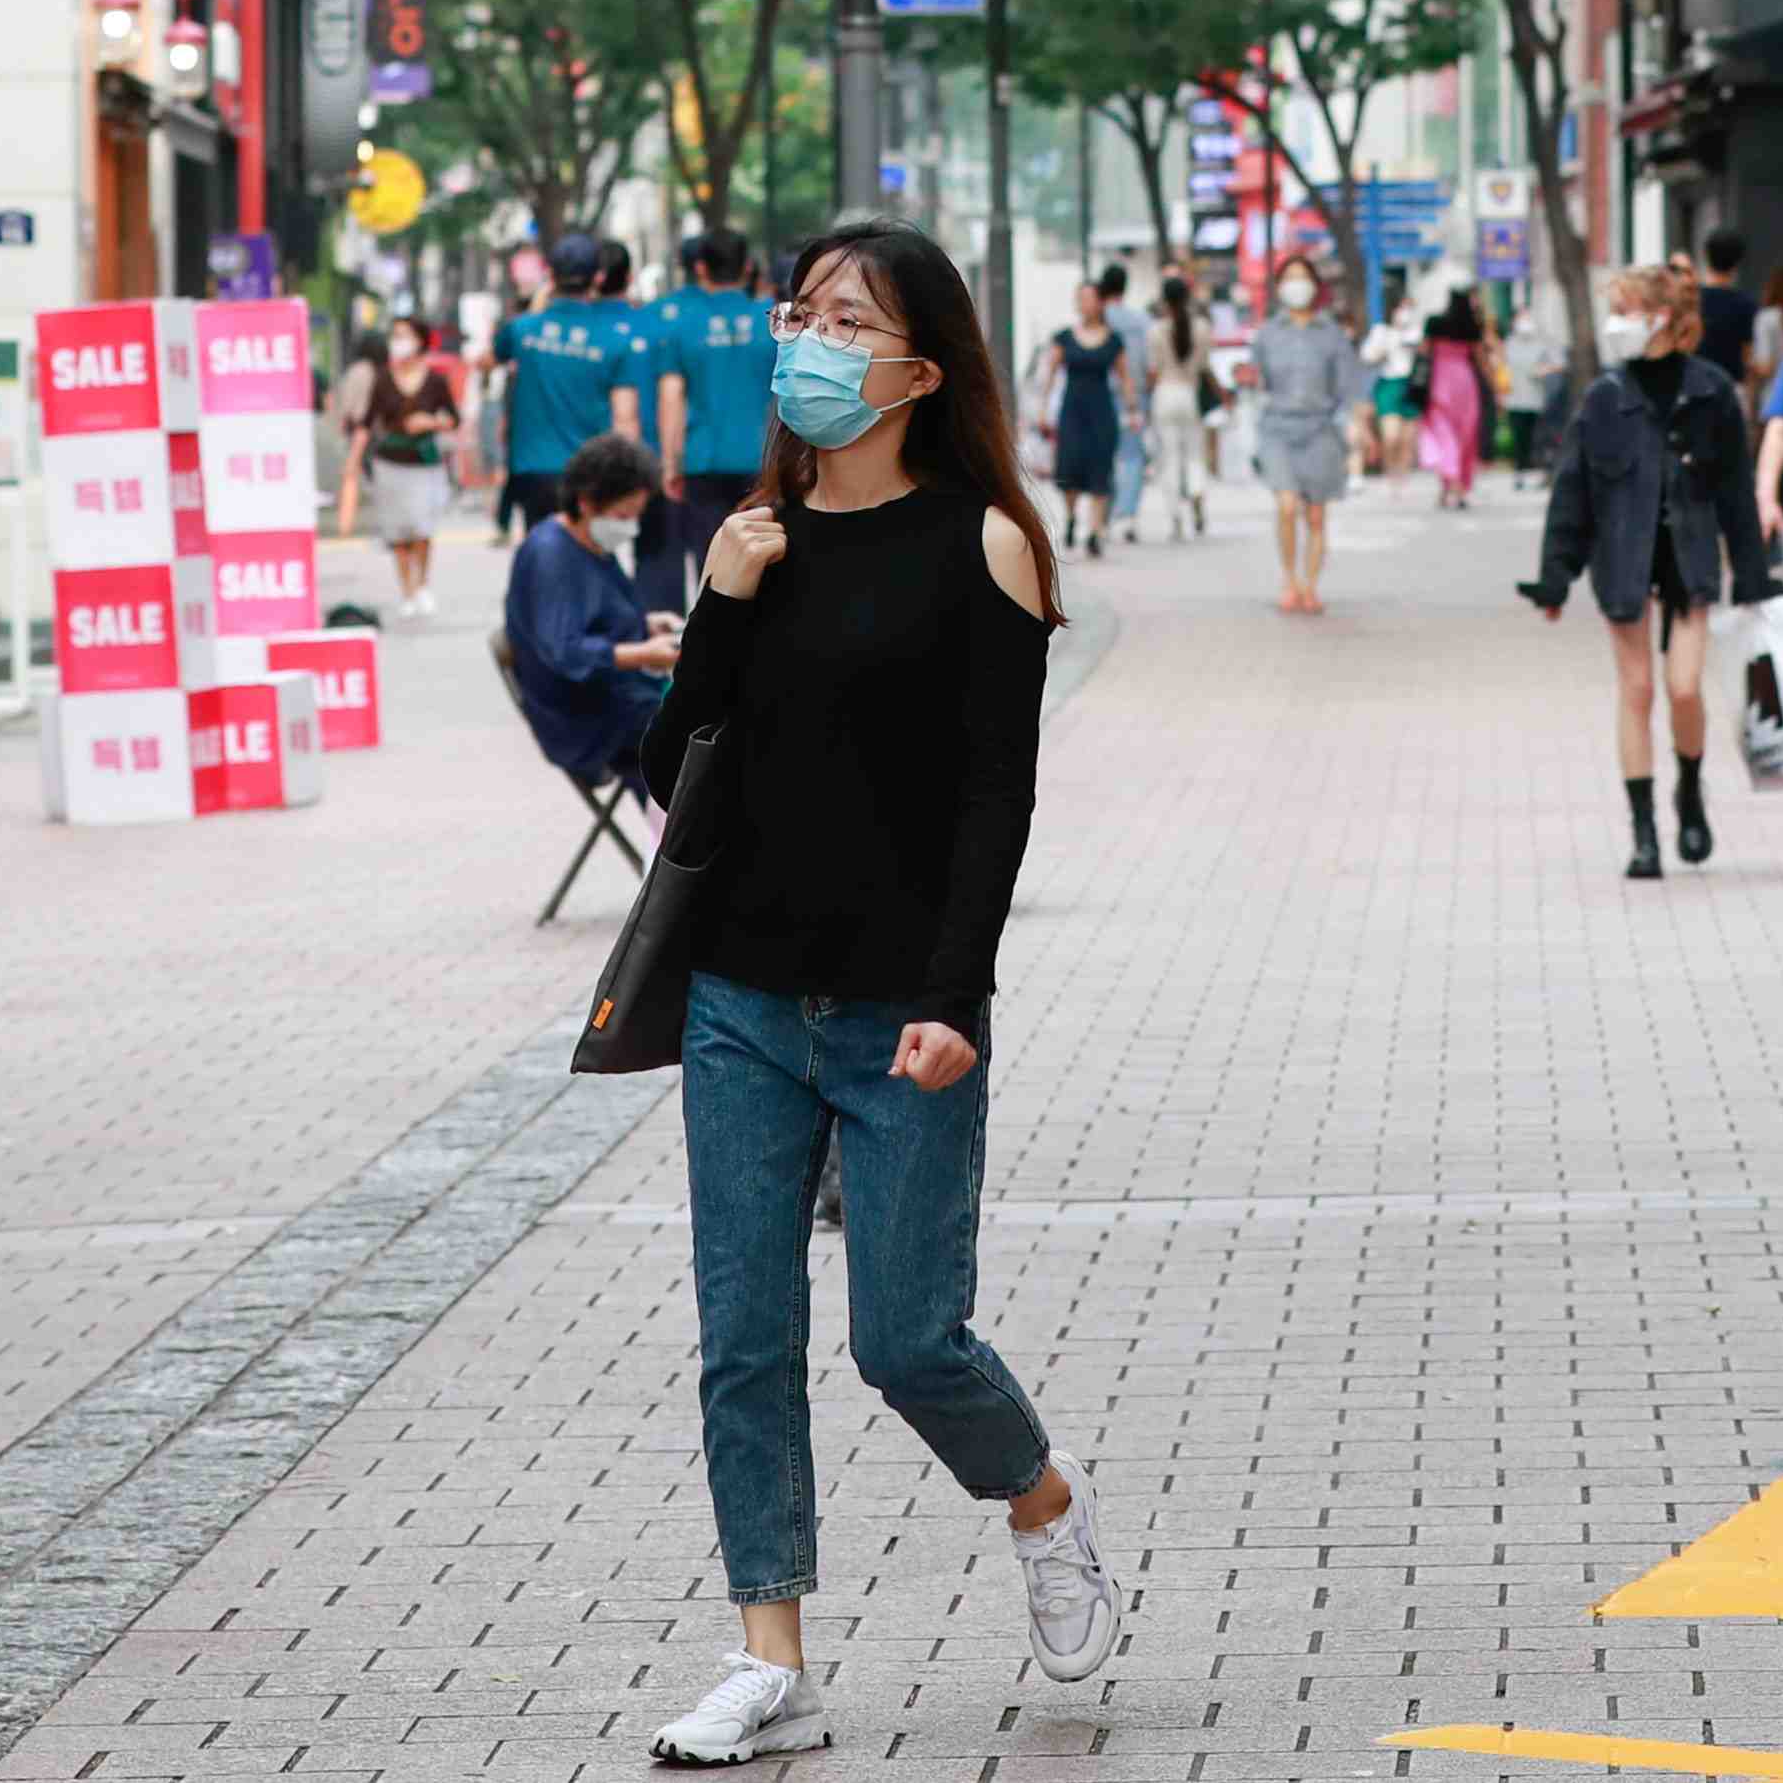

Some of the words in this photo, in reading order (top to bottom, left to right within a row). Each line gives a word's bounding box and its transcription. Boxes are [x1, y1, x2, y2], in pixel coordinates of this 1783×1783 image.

[50, 342, 149, 391] SALE
[207, 333, 297, 376] SALE
[218, 559, 307, 601] SALE
[68, 602, 166, 649] SALE
